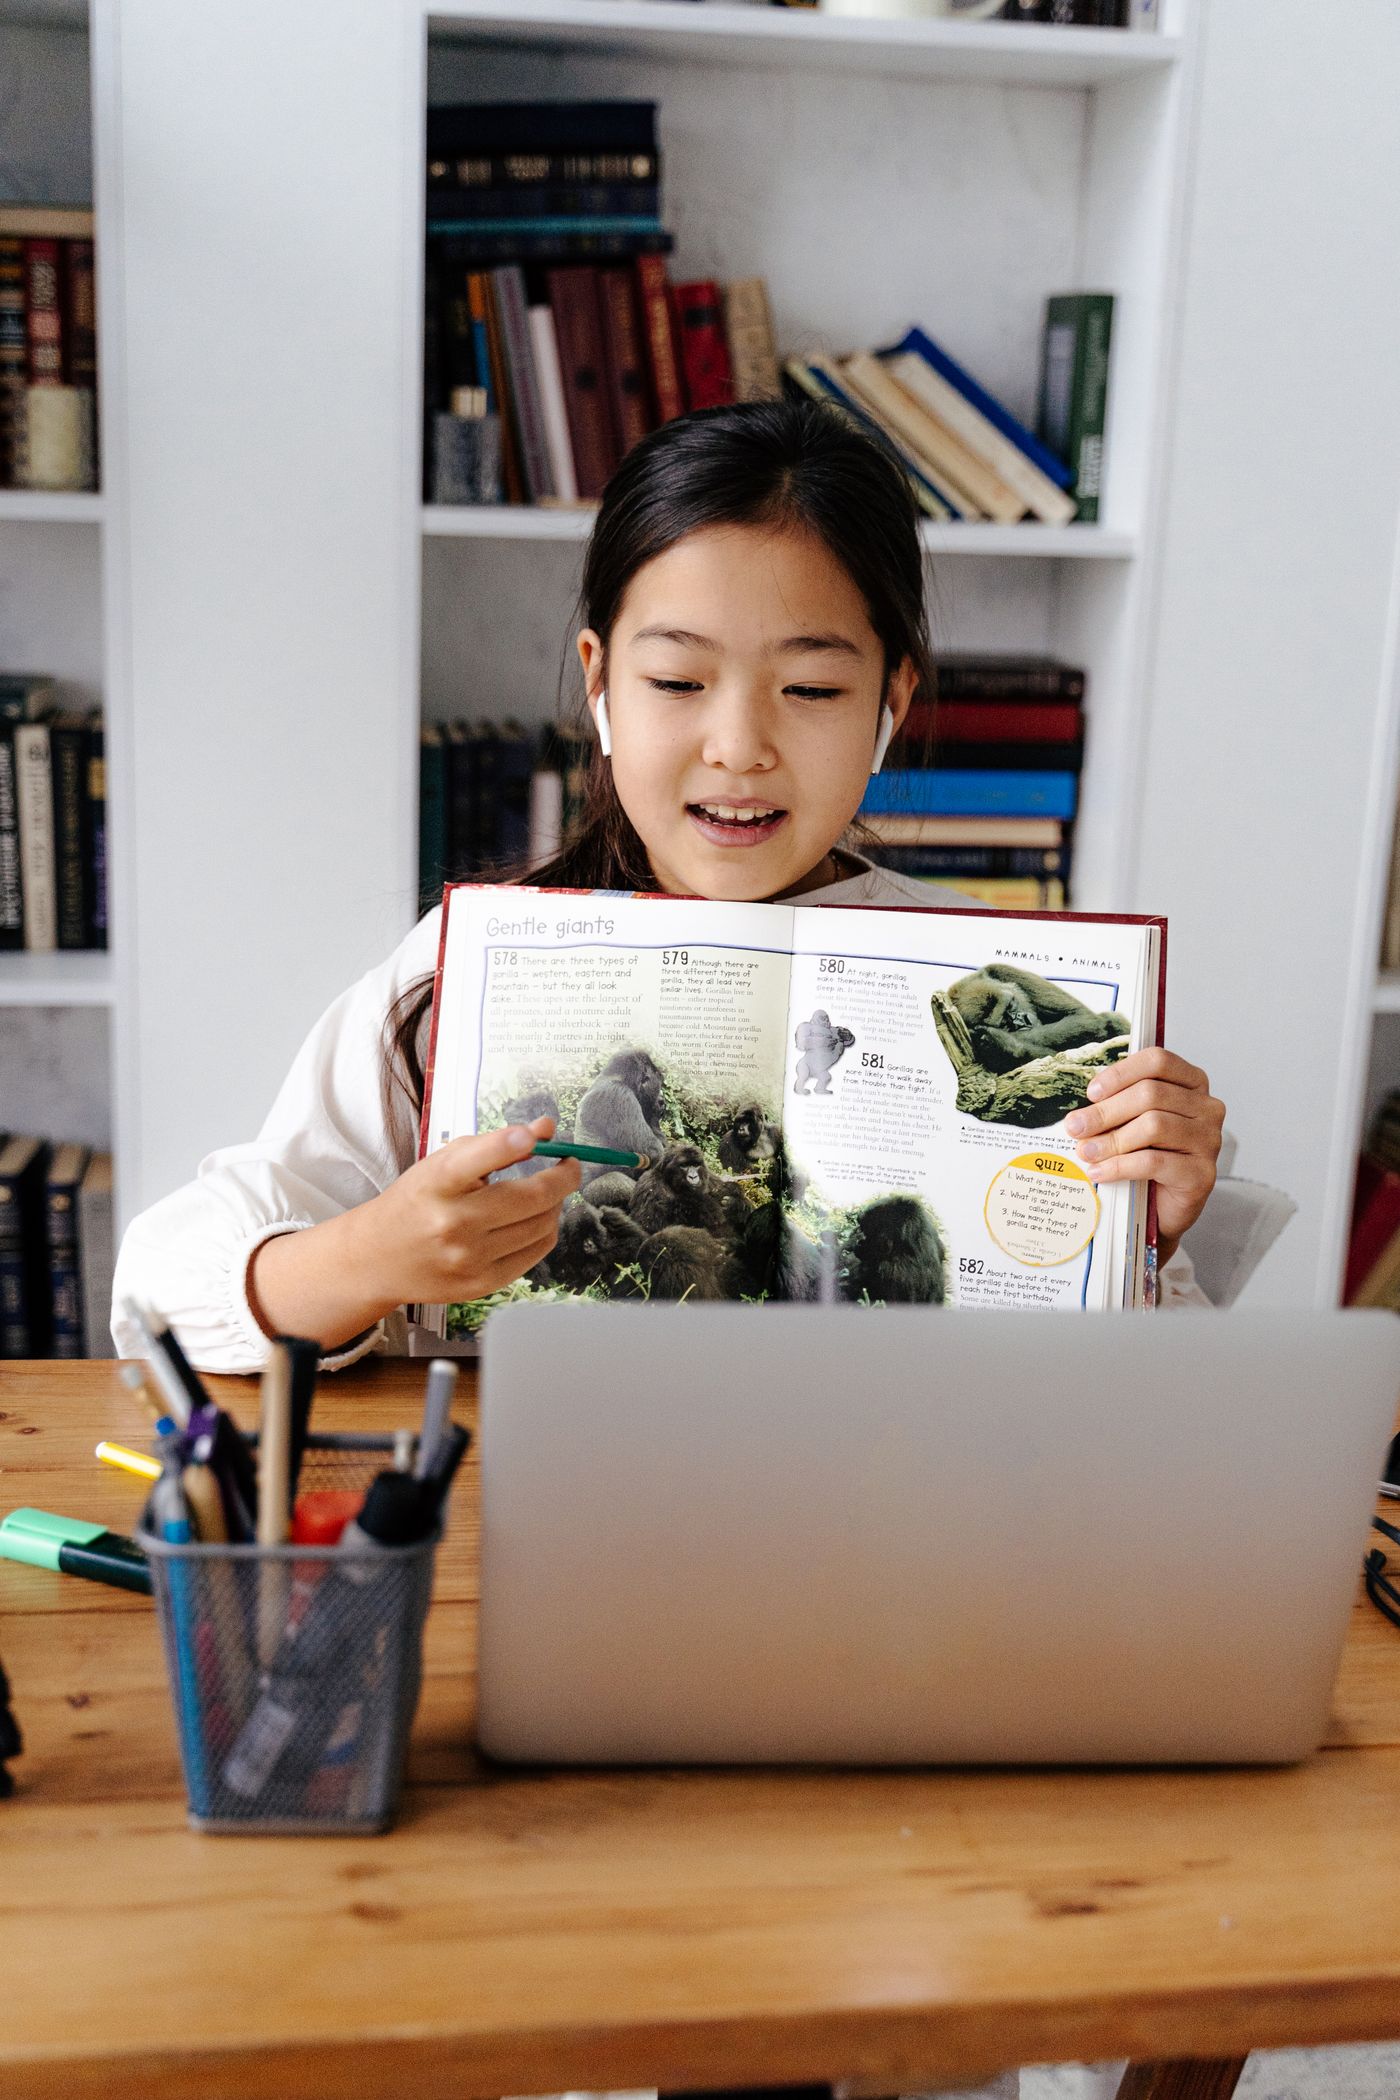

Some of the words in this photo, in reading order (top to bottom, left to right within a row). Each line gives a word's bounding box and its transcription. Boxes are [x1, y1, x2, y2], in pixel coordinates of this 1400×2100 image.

[486, 917, 547, 937] Gentle
[556, 916, 615, 938] giants
[494, 952, 518, 965] 578
[521, 957, 547, 965] There
[571, 957, 594, 965] three
[600, 957, 624, 966] types
[628, 956, 638, 965] of
[663, 951, 688, 965] 579
[692, 960, 721, 968] Although
[995, 949, 1049, 961] MAMMALS
[1072, 958, 1120, 969] ANIMALS
[493, 971, 519, 980] gorilla
[532, 970, 571, 978] western,
[615, 969, 631, 977] and
[684, 968, 717, 976] different
[721, 970, 740, 978] types
[820, 959, 844, 973] 580
[859, 971, 879, 979] night,
[882, 973, 907, 981] gorillas
[562, 982, 580, 991] they
[838, 977, 875, 986] themselves
[583, 994, 596, 1002] the
[600, 995, 628, 1006] largest
[632, 994, 642, 1002] of
[545, 1007, 561, 1015] and
[608, 1007, 631, 1015] adult
[558, 1018, 600, 1028] silverback
[545, 1032, 550, 1040] 2
[597, 1031, 625, 1043] height
[862, 1053, 884, 1068] 581
[887, 1064, 913, 1073] Gorillas
[843, 1076, 858, 1084] from
[862, 1079, 886, 1088] trouble
[908, 1085, 926, 1094] fight.
[865, 1070, 883, 1079] likely
[915, 1078, 932, 1086] away
[1035, 1158, 1065, 1172] QUIZ
[1008, 1171, 1014, 1179] 1.
[1016, 1173, 1033, 1182] What
[1045, 1179, 1056, 1187] the
[1059, 1182, 1084, 1194] largest
[1010, 1191, 1029, 1201] What
[1051, 1200, 1069, 1208] adult
[1028, 1187, 1060, 1197] primate?
[1029, 1205, 1054, 1215] called?
[1012, 1210, 1025, 1218] How
[1028, 1214, 1045, 1223] many
[1048, 1218, 1067, 1228] types
[1007, 1220, 1028, 1228] gorilla
[1045, 1226, 1069, 1236] there?
[959, 1258, 984, 1274] 582
[986, 1269, 1007, 1277] About
[1051, 1278, 1071, 1286] every
[960, 1274, 973, 1282] five
[976, 1278, 1001, 1287] gorillas
[1018, 1283, 1041, 1291] before
[1044, 1287, 1060, 1295] they
[961, 1294, 979, 1302] Some
[993, 1298, 1011, 1306] killed
[1013, 1301, 1021, 1309] by
[1004, 1290, 1019, 1298] first
[1023, 1293, 1054, 1303] birthday.
